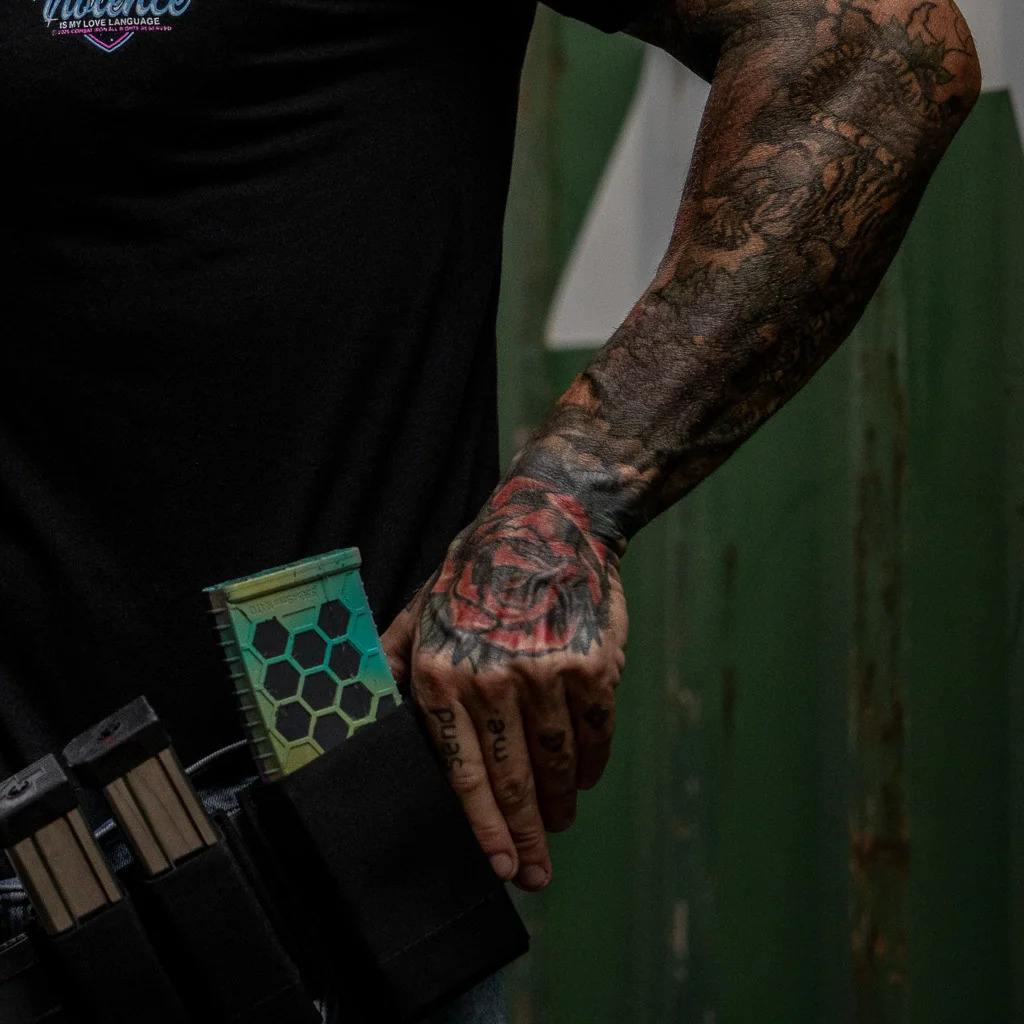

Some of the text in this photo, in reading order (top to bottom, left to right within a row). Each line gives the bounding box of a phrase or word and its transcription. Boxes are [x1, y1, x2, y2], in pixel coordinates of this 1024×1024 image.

[59, 16, 161, 29] IS MY LOVE LANGUAGE
[429, 707, 463, 773] send
